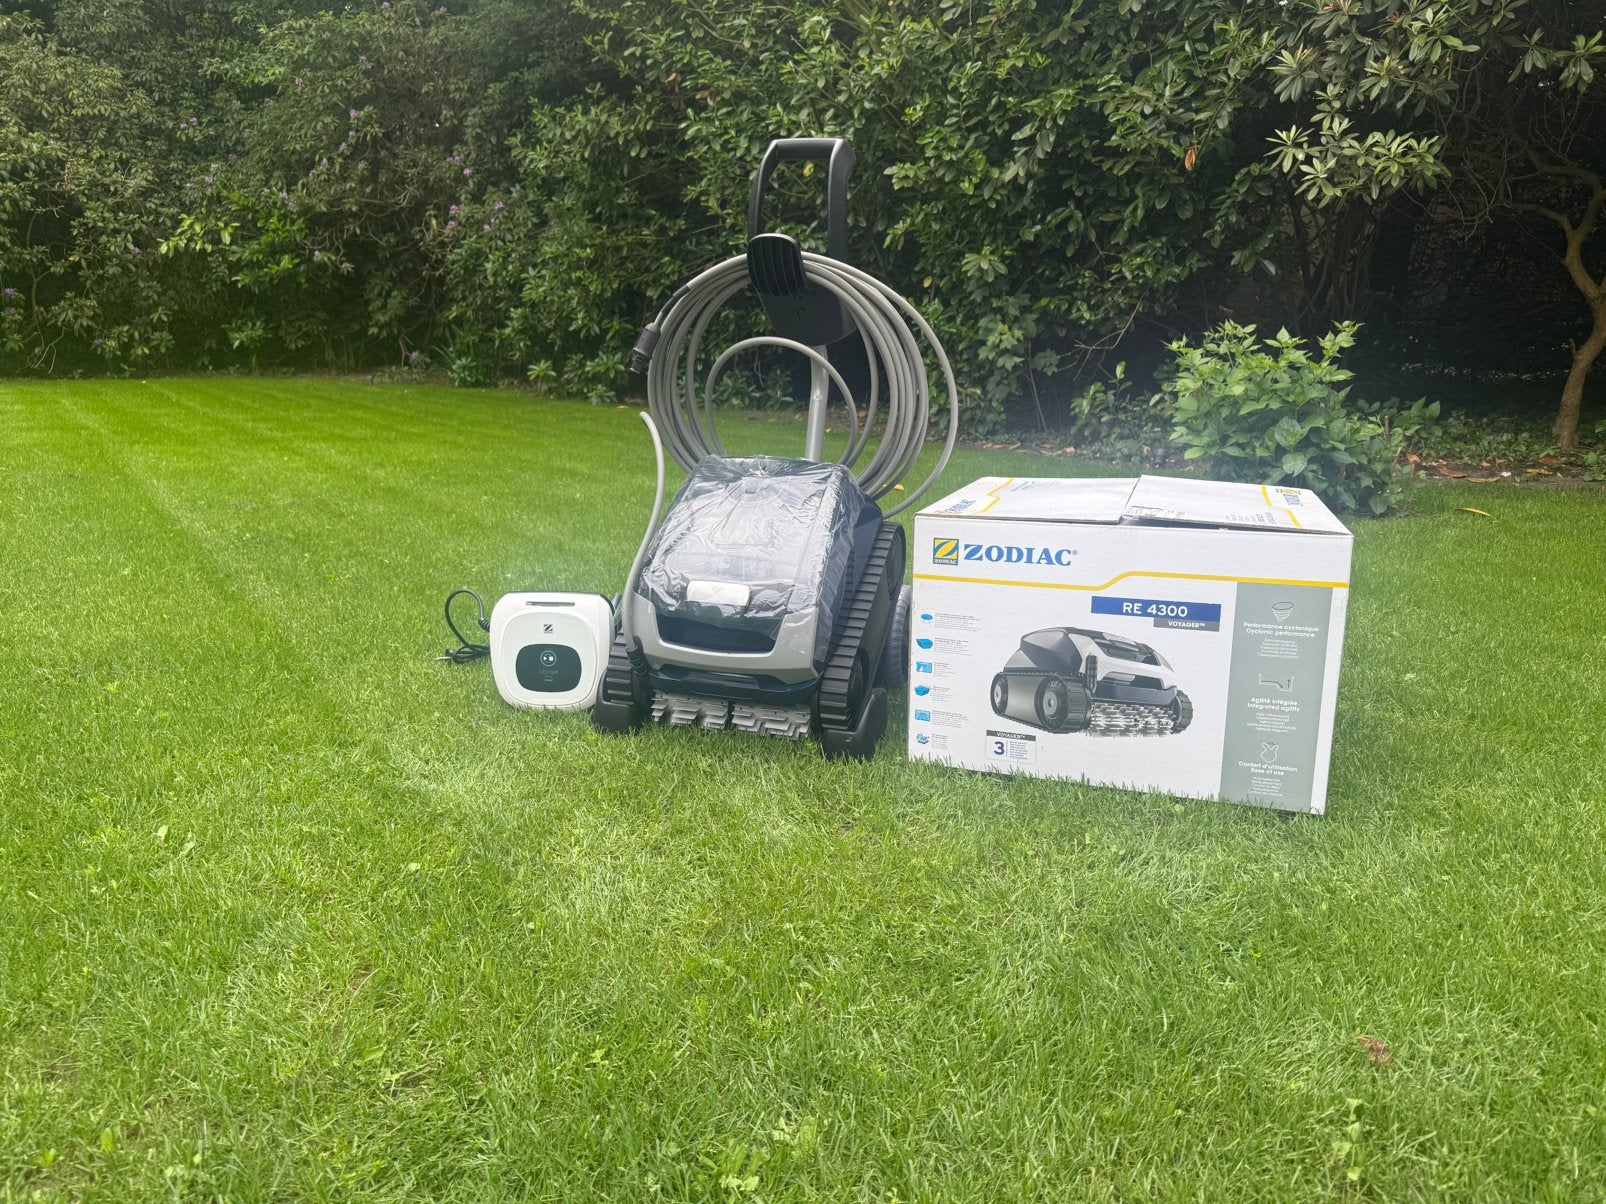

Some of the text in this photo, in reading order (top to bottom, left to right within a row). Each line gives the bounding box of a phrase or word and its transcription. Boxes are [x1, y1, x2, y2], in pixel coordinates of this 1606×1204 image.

[1122, 602, 1188, 618] RE 4300
[1243, 622, 1283, 630] Performance
[1274, 630, 1315, 638] performance
[1247, 702, 1300, 712] Integrated agility
[993, 741, 1005, 756] 3
